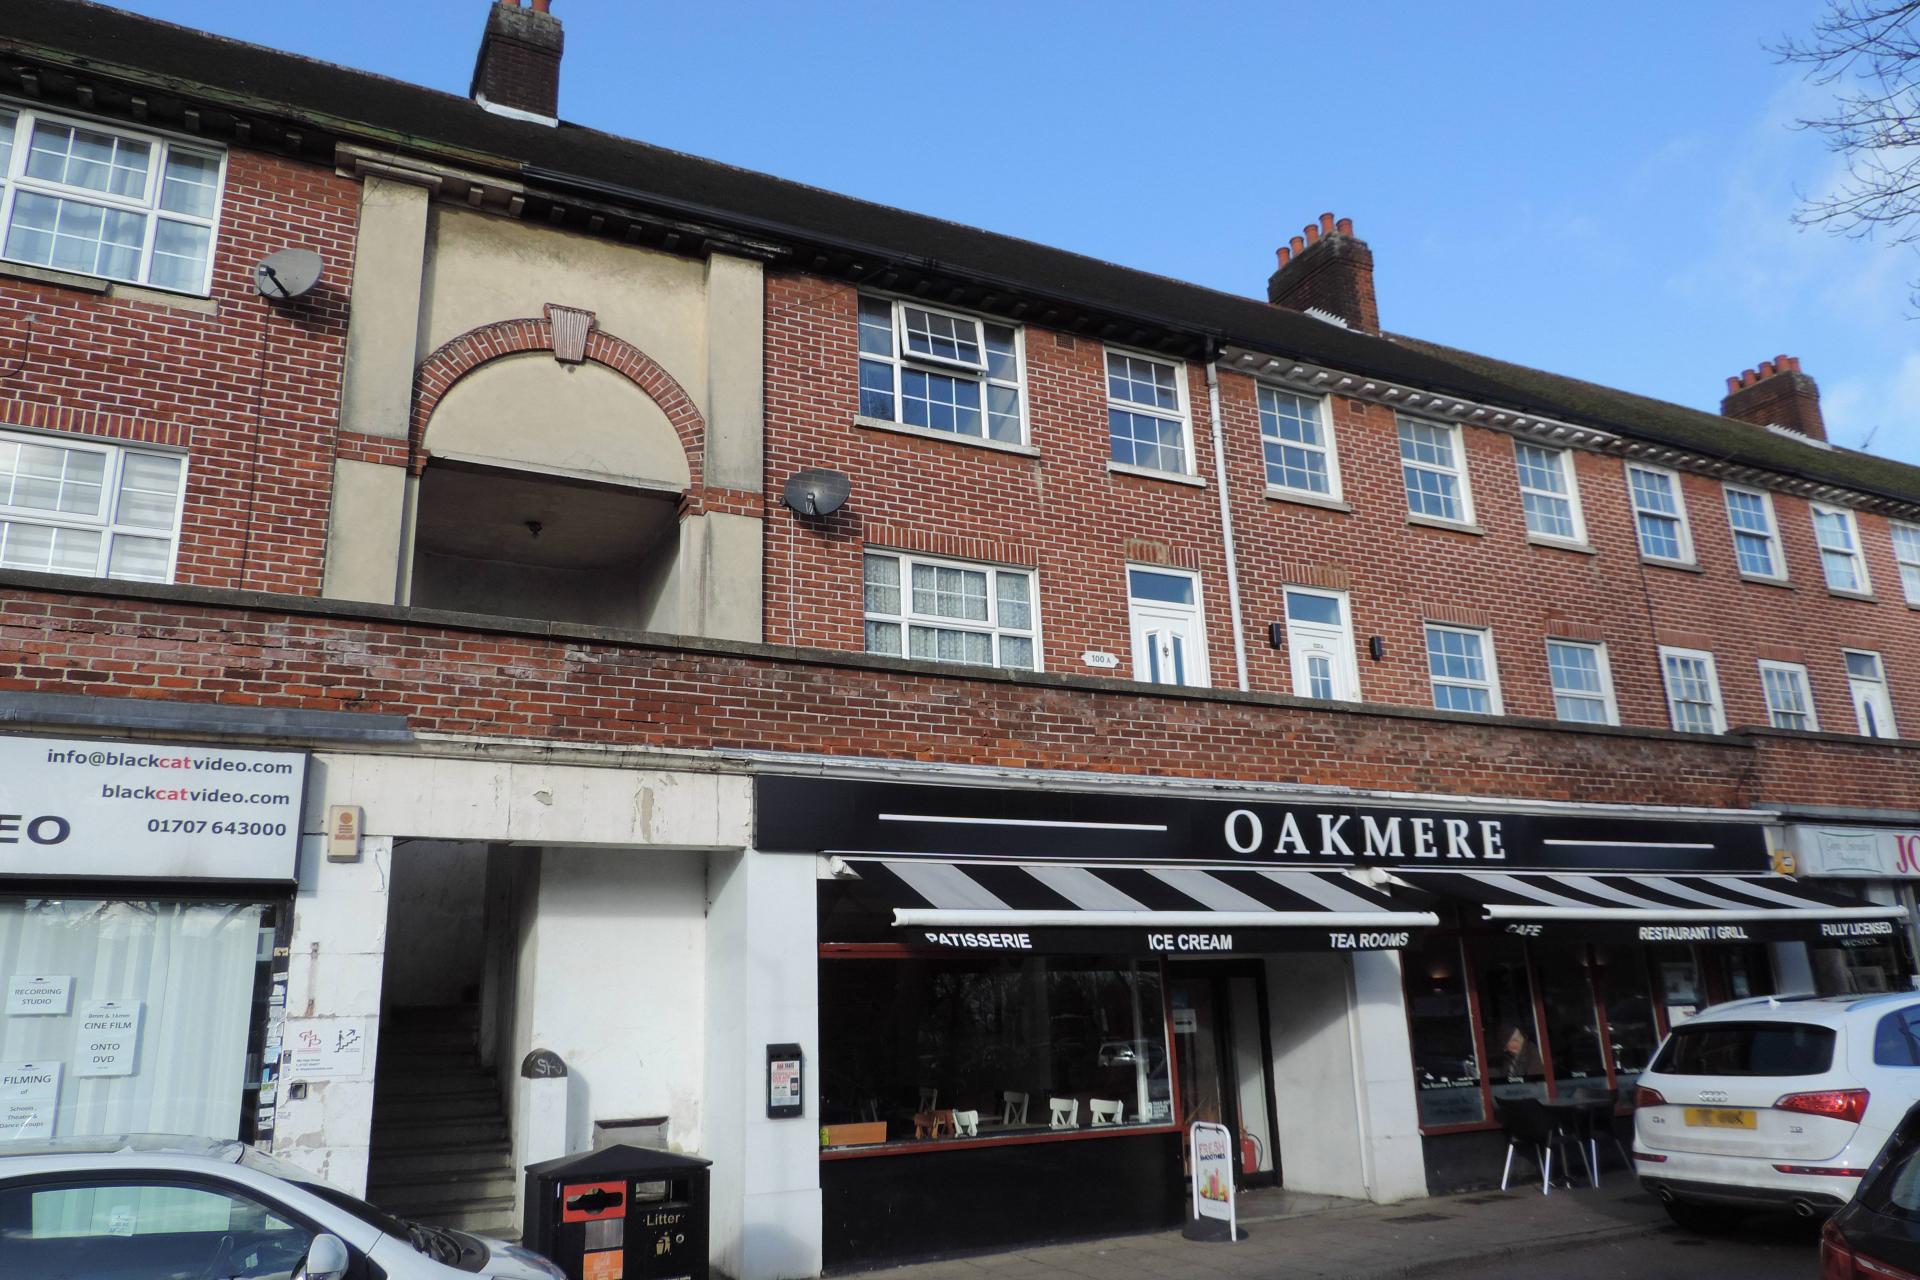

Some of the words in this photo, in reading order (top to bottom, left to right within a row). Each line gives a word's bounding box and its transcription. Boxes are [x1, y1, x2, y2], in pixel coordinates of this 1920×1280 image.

[47, 749, 293, 774] info@blackcatvideo.com
[101, 783, 290, 805] blackcatvideo.com
[147, 818, 207, 834] 01707
[211, 820, 287, 836] 643000
[1224, 809, 1506, 860] OAKMERE
[1505, 924, 1543, 936] CAFE
[1639, 926, 1710, 940] RESTAURANT
[1717, 926, 1748, 939] GRILL
[1821, 923, 1850, 936] FULLY
[1851, 921, 1893, 935] LICENSED
[924, 932, 1033, 949] PATISSERIE
[1148, 934, 1174, 949] ICE
[1177, 934, 1233, 950] CREAM
[1329, 932, 1356, 948] TEA
[1359, 932, 1409, 947] ROOMS
[14, 988, 62, 996] RECORDING
[22, 998, 52, 1006] STUDIO
[84, 1022, 107, 1030] CINE
[109, 1021, 132, 1029] FILM
[90, 1043, 120, 1051] ONTO
[92, 1055, 115, 1063] DVD
[3, 1074, 52, 1085] FILMING
[646, 1213, 681, 1227] Litter
